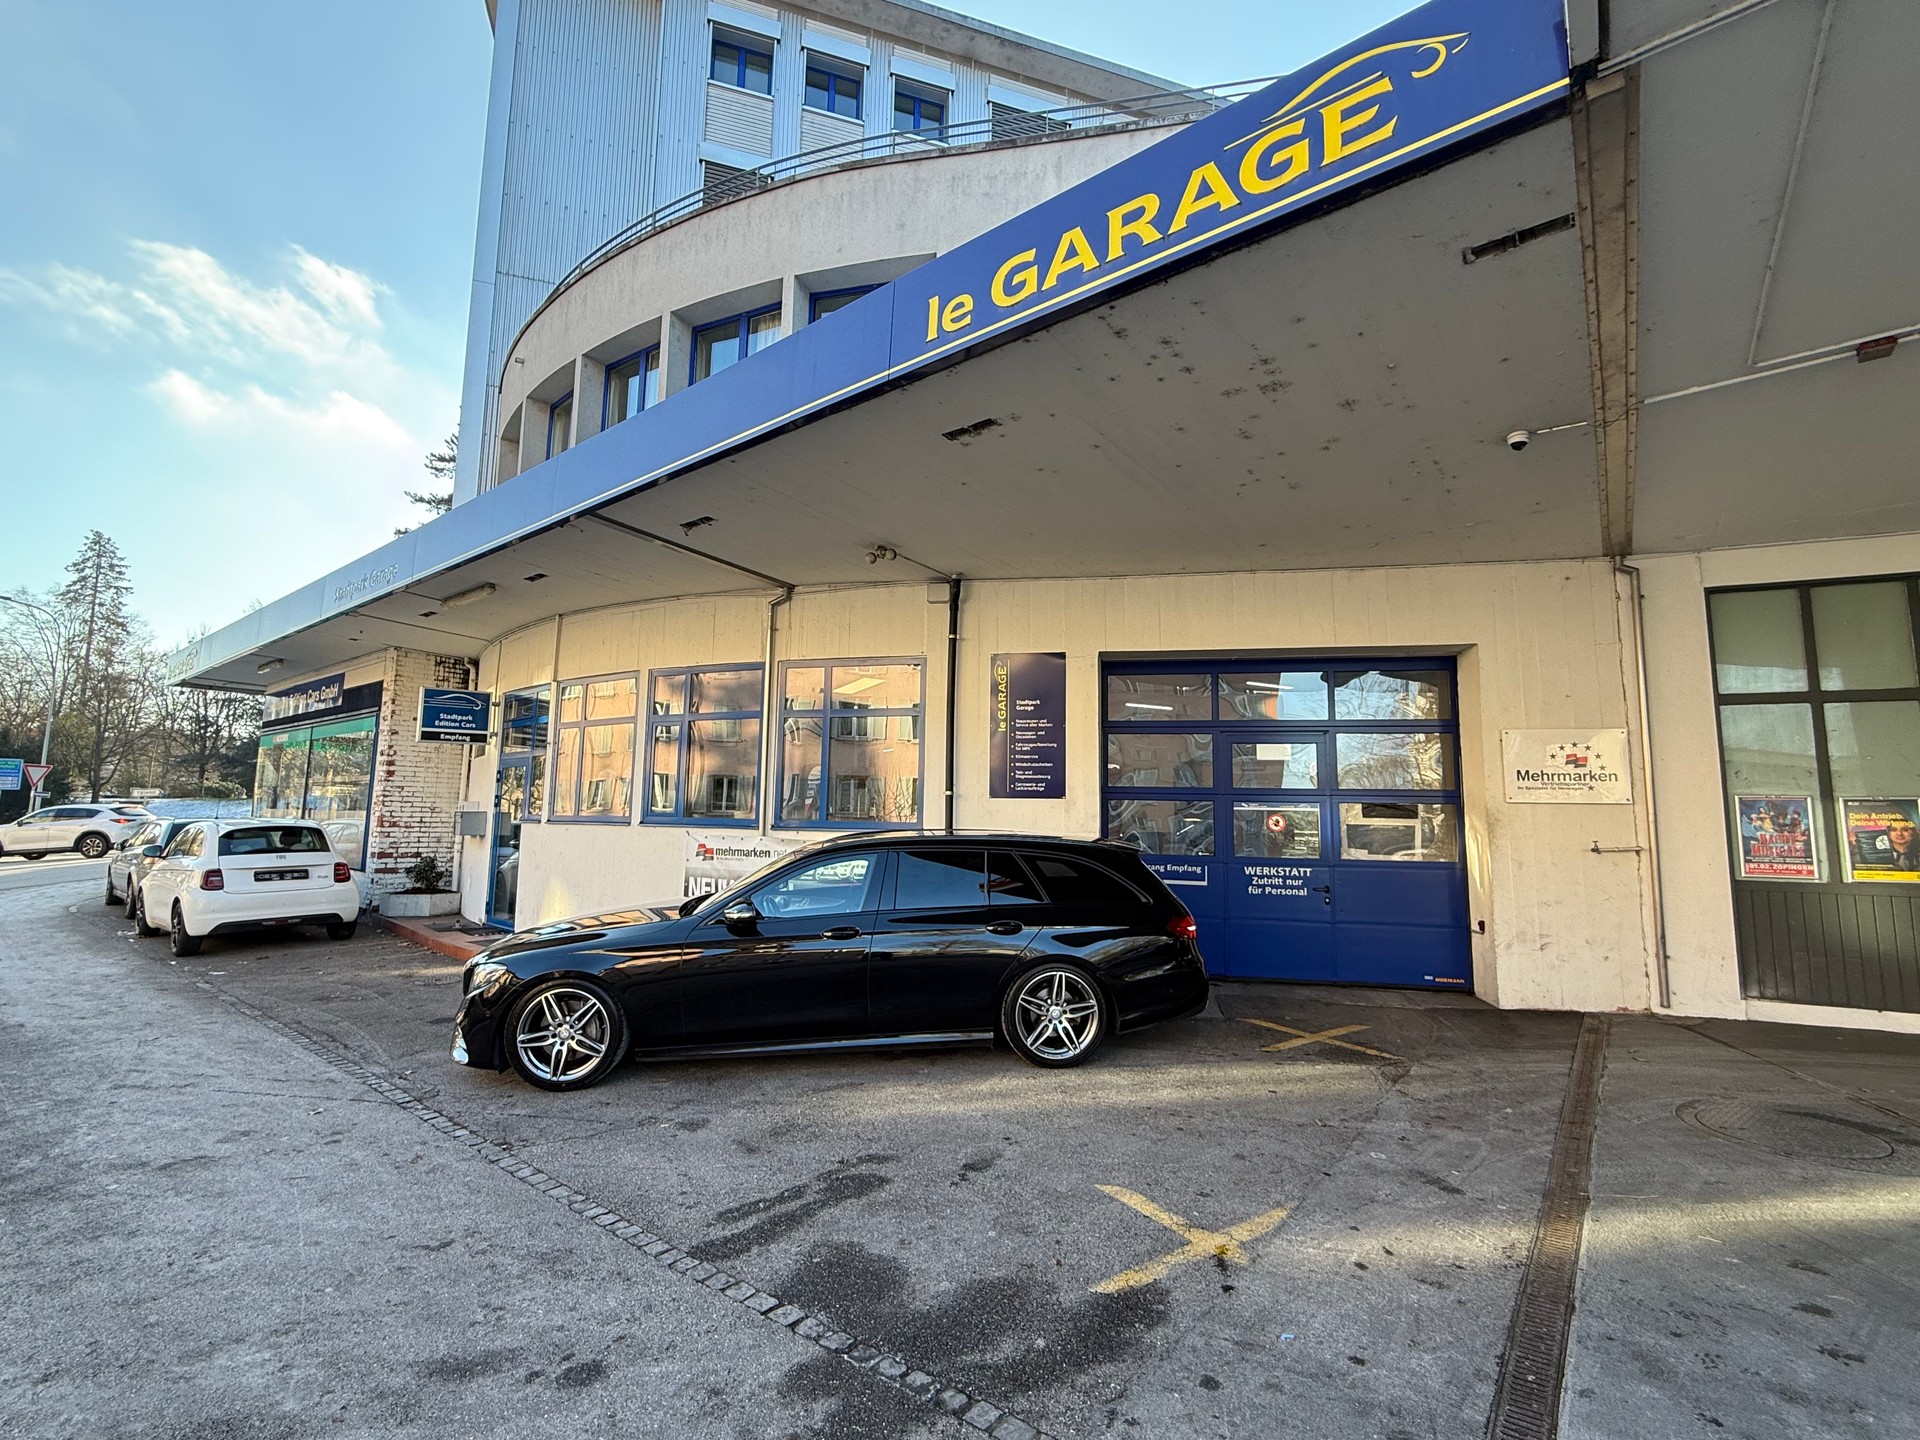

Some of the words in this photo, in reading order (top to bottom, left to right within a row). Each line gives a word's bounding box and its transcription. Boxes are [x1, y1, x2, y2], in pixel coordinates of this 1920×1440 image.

[926, 293, 973, 342] le
[990, 76, 1399, 308] GARAGE
[369, 563, 399, 587] Garage
[307, 689, 320, 703] Cars
[321, 682, 339, 699] GmbH
[998, 666, 1007, 720] GARAGE
[440, 713, 473, 721] Stadtpark
[998, 721, 1007, 732] le
[440, 733, 471, 742] Empfang
[1516, 769, 1618, 782] Mehrmarken
[1871, 812, 1904, 820] Antrieb.
[1167, 864, 1202, 873] Empfang
[1244, 866, 1312, 877] WERKSTATT
[1773, 863, 1814, 871] ZOFINGEN
[1252, 877, 1283, 886] Zutritt
[1248, 886, 1263, 895] für
[1265, 887, 1308, 896] Personal
